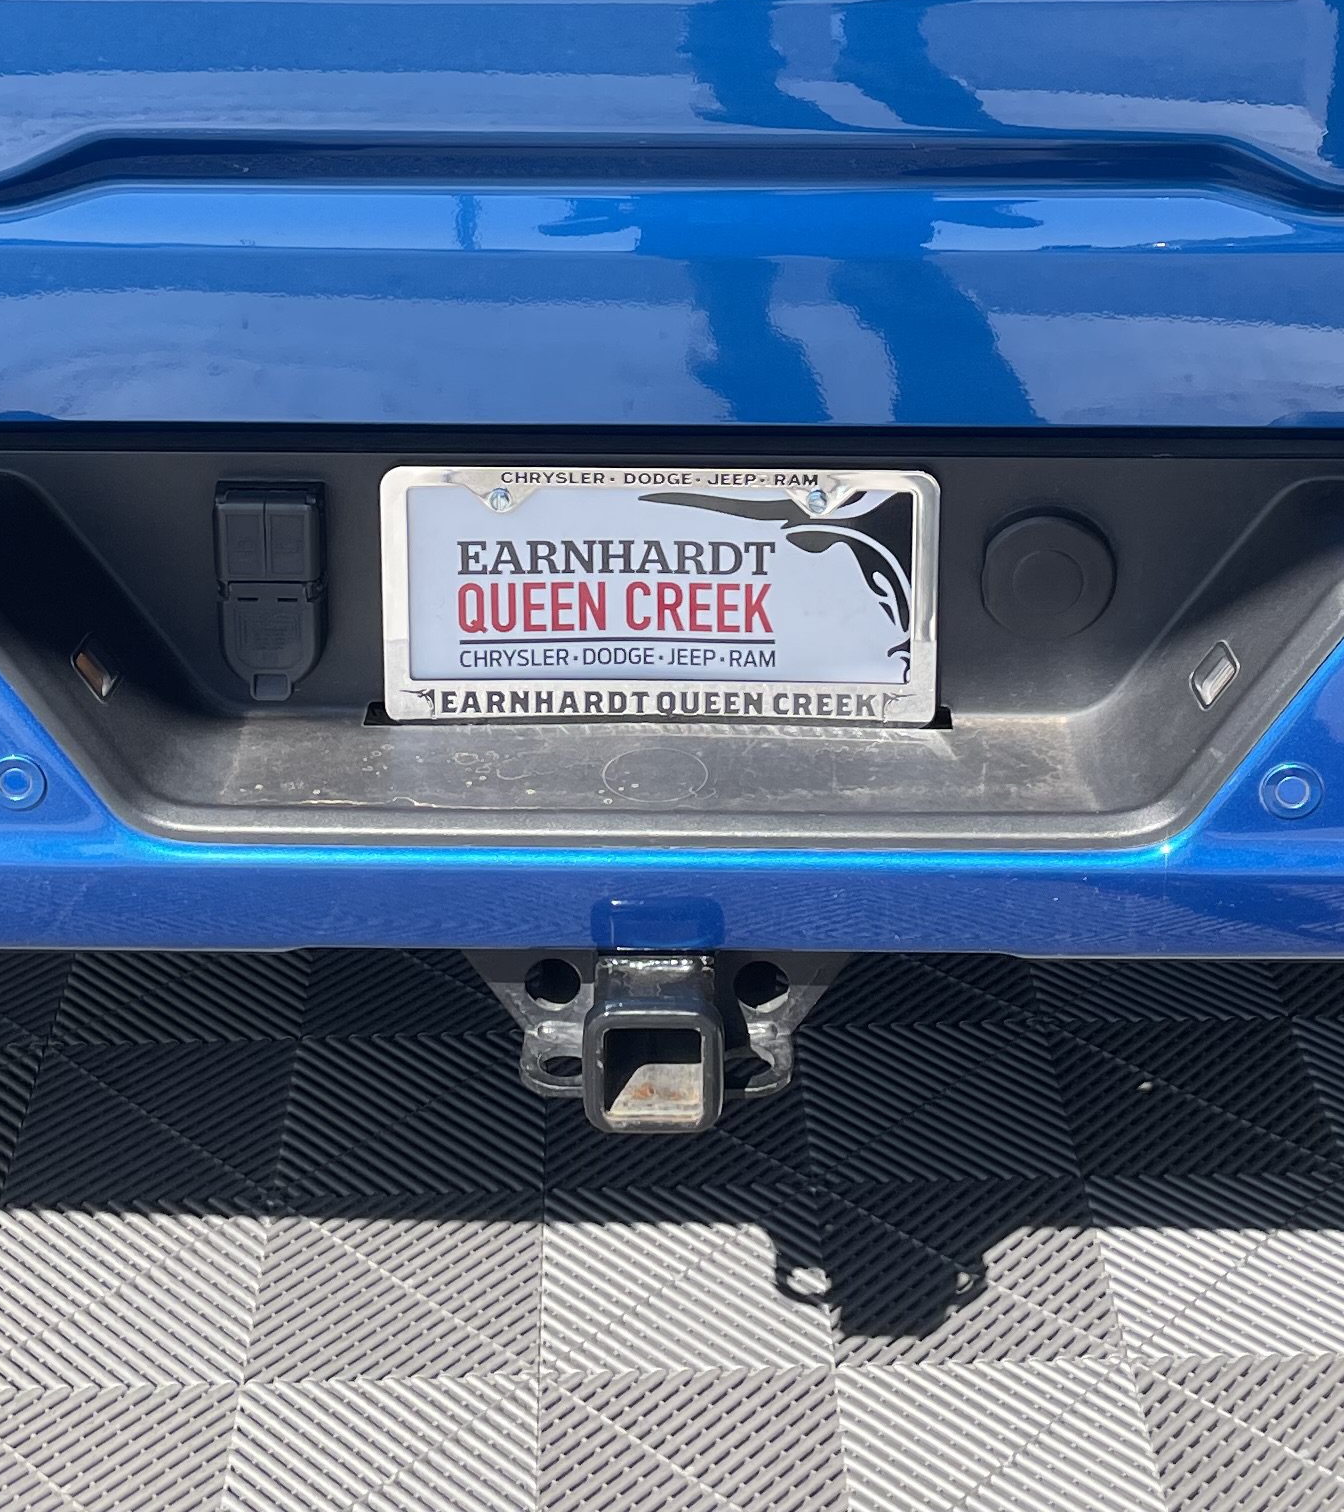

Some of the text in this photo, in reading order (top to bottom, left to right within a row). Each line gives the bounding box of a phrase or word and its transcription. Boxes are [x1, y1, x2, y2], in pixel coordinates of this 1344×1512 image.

[501, 471, 819, 486] CHRYSLER DODGE JEEP RAM
[457, 540, 776, 576] EARNHARDT
[457, 581, 774, 634] QUEEN CREEK
[459, 647, 776, 668] CHRYSLER DODGE JEEP RAM
[441, 690, 878, 717] EARNHARDT QUEEN CREEK
